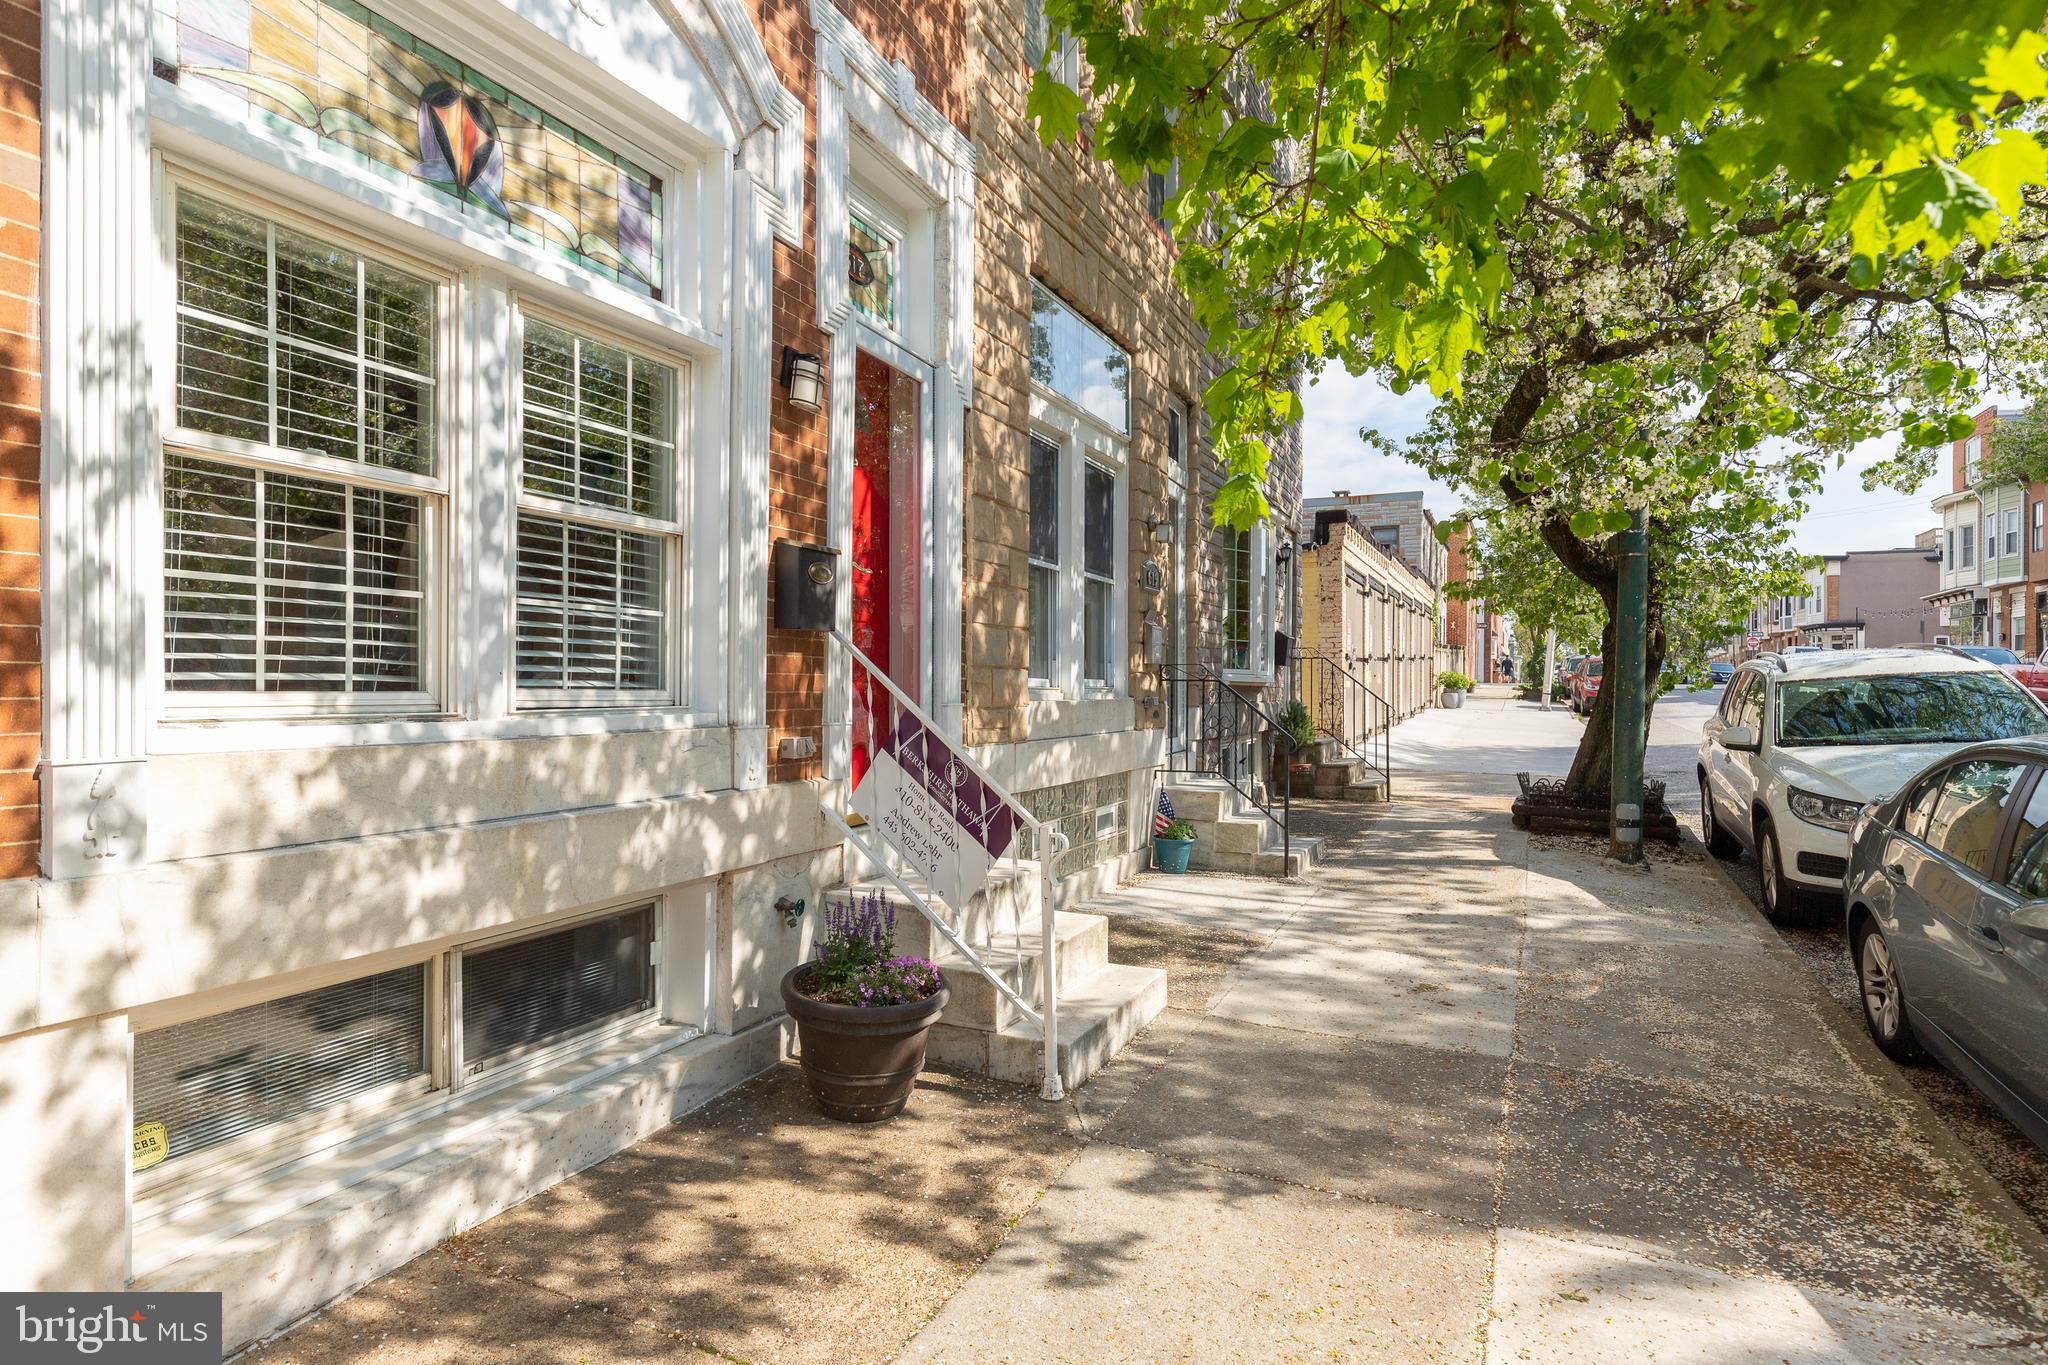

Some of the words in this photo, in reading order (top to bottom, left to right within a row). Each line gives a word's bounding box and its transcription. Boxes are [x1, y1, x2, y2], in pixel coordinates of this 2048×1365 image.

[902, 747, 948, 793] BERKHIRE
[890, 808, 923, 840] Andrew
[134, 1126, 163, 1137] ARNING
